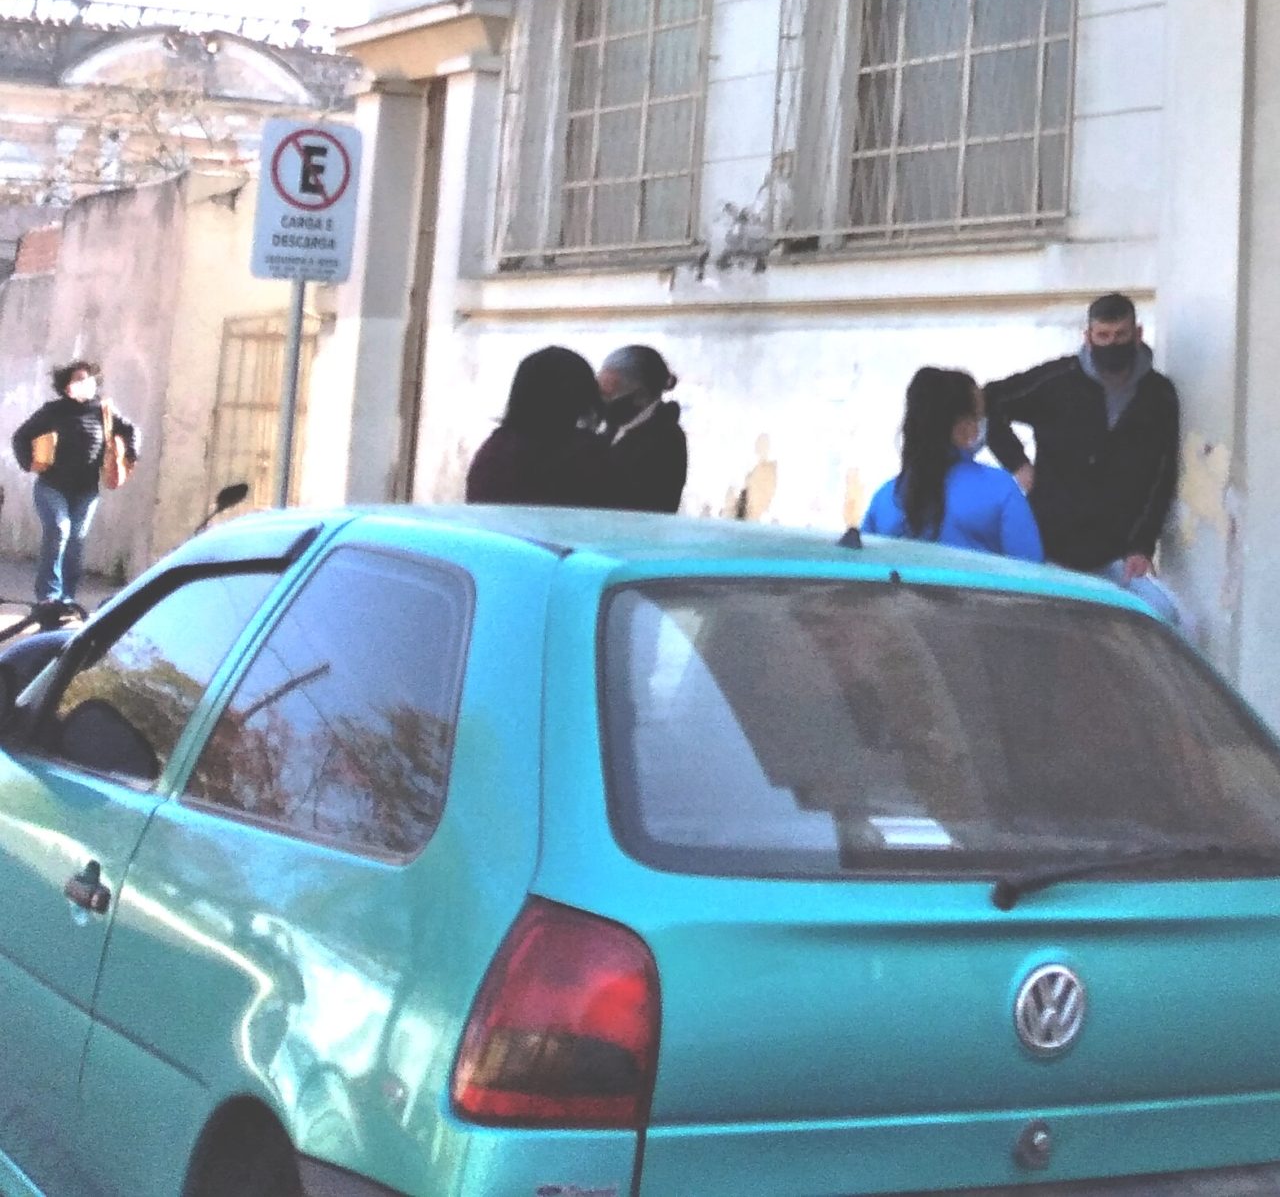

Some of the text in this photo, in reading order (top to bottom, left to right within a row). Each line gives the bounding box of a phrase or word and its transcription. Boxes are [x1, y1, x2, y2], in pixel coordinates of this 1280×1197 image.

[300, 144, 328, 194] E
[281, 214, 322, 230] CARGA
[271, 233, 335, 250] DESCARGA
